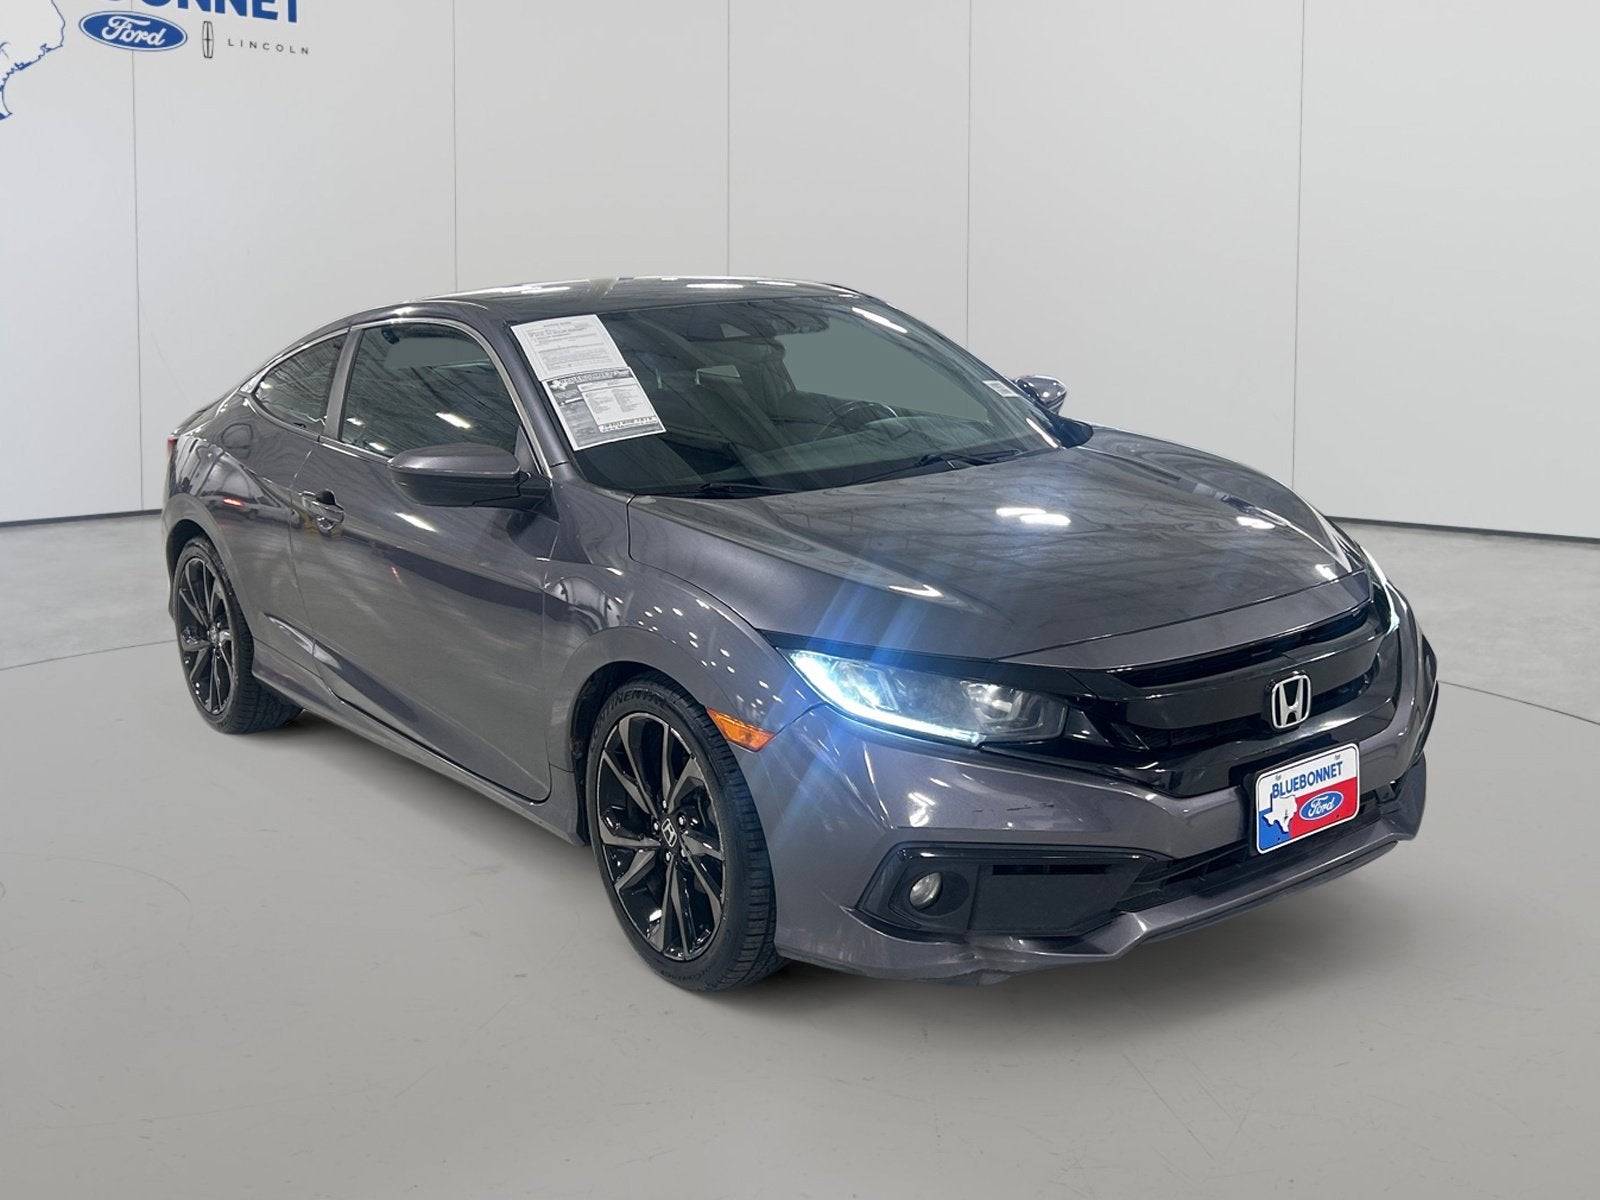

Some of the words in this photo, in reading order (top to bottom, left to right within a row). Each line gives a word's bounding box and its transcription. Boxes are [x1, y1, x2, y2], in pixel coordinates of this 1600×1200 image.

[101, 16, 166, 46] Ford
[228, 38, 309, 55] LINCOLN
[1271, 761, 1343, 798] BLUEBONNET
[1307, 795, 1336, 818] Ford
